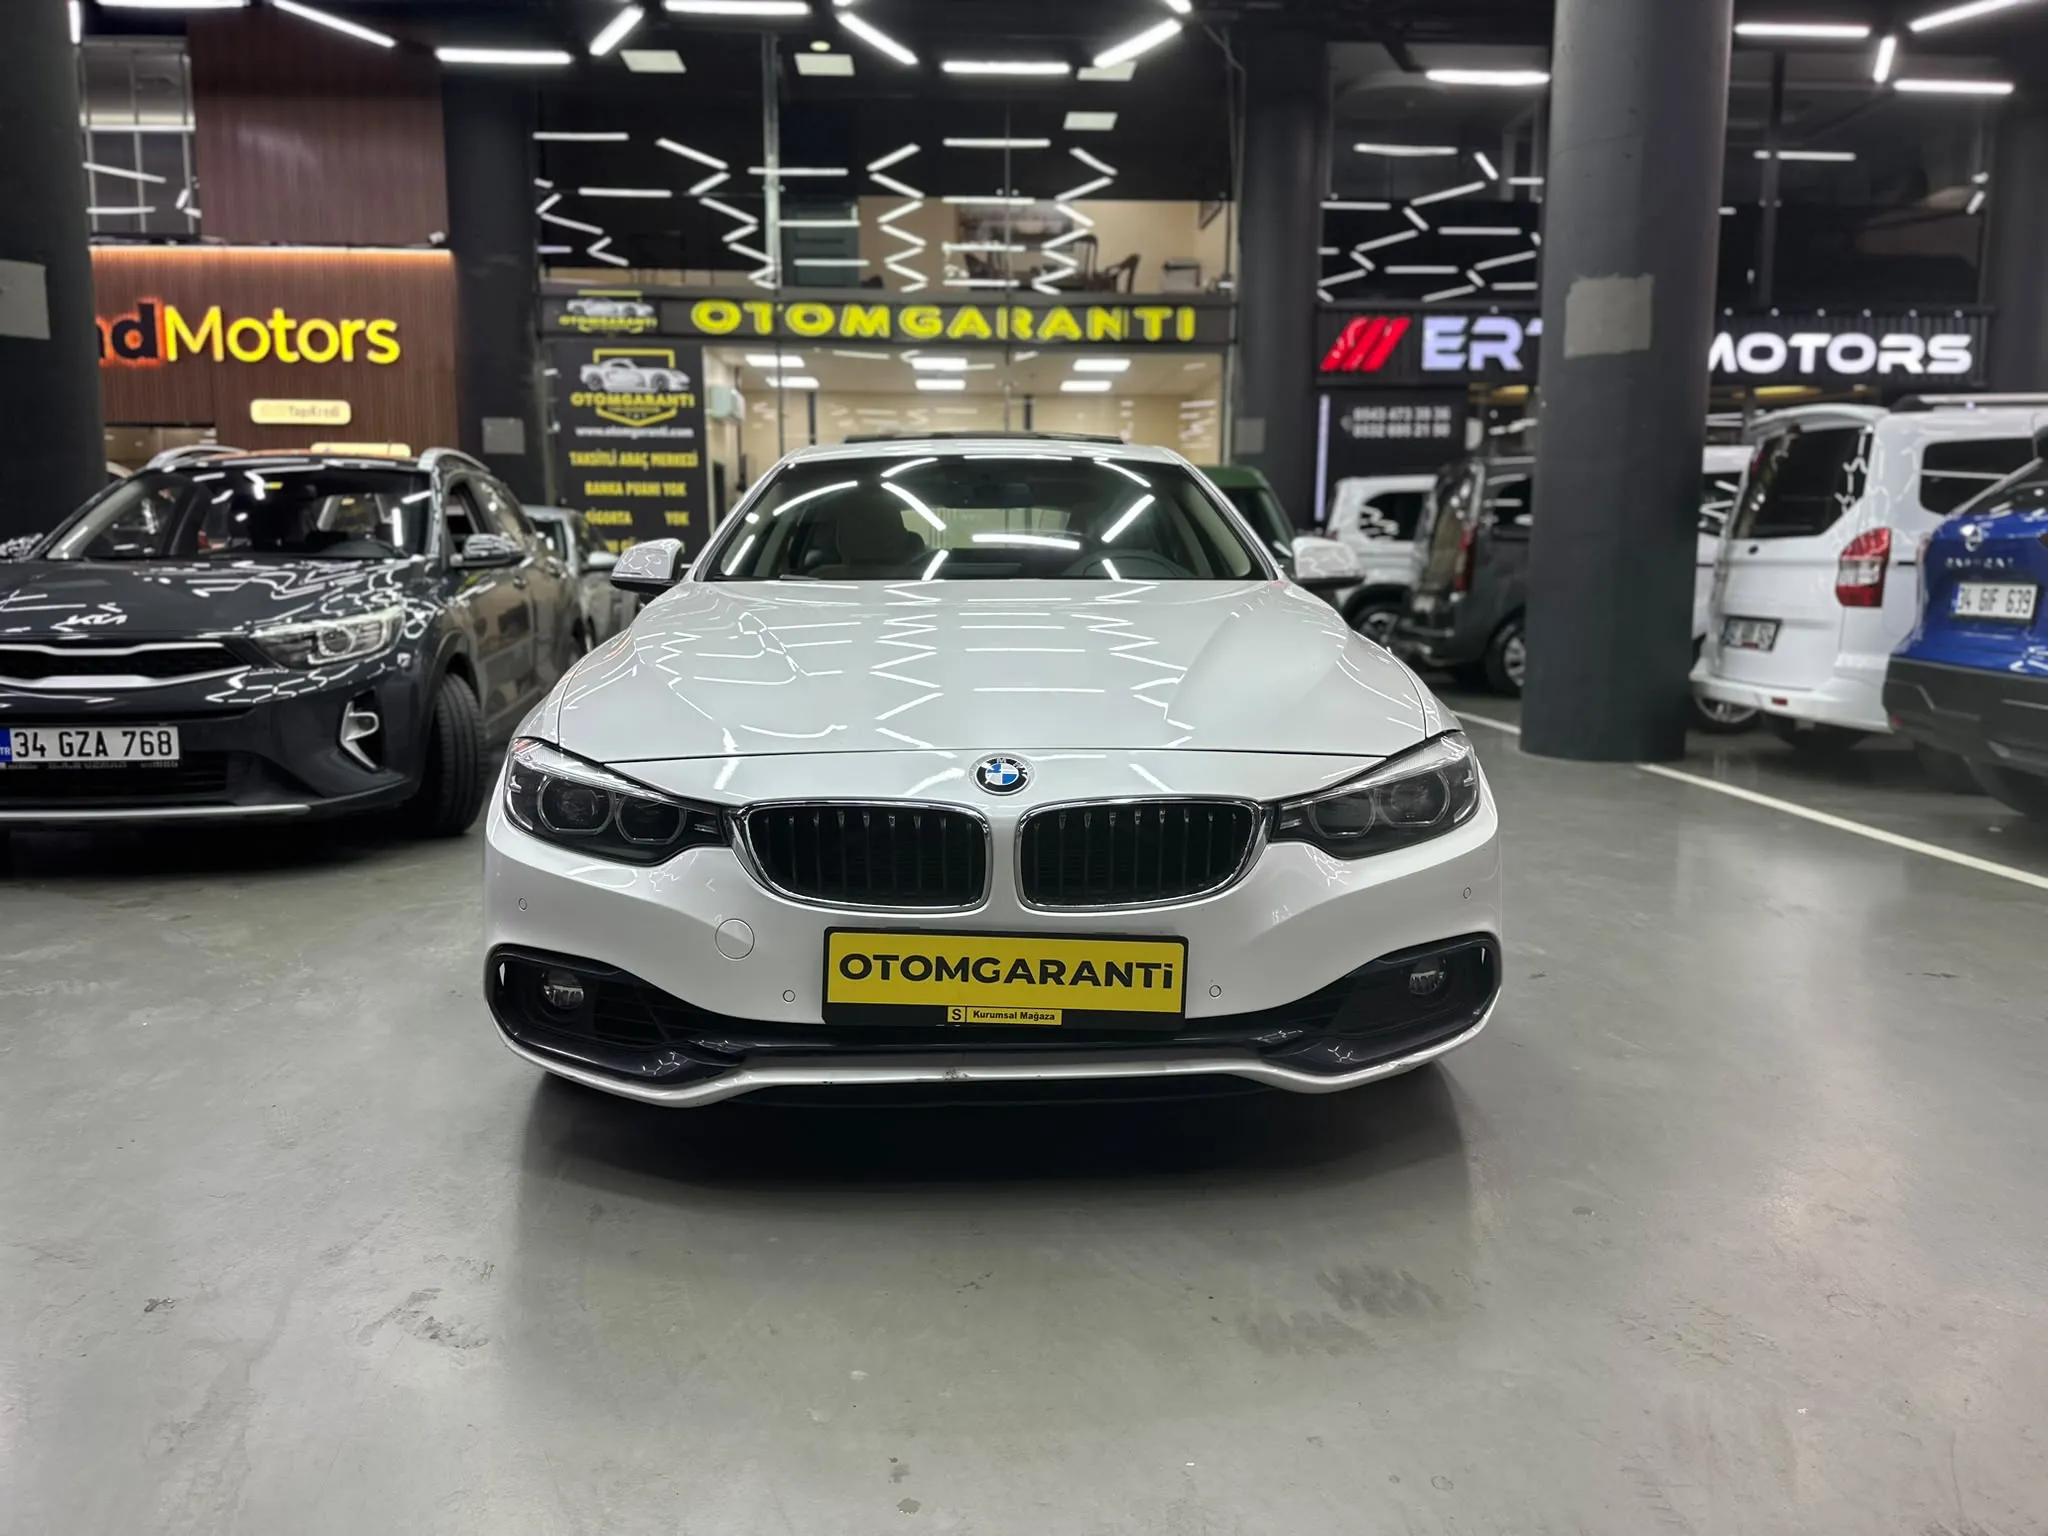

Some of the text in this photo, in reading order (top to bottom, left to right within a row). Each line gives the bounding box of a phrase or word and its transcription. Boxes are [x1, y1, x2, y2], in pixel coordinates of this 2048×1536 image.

[690, 301, 1197, 342] OTOMGARANTI
[14, 730, 173, 758] 34 GZA 768
[951, 1008, 962, 1021] S
[973, 1010, 1056, 1022] Kurumsal Mağaza
